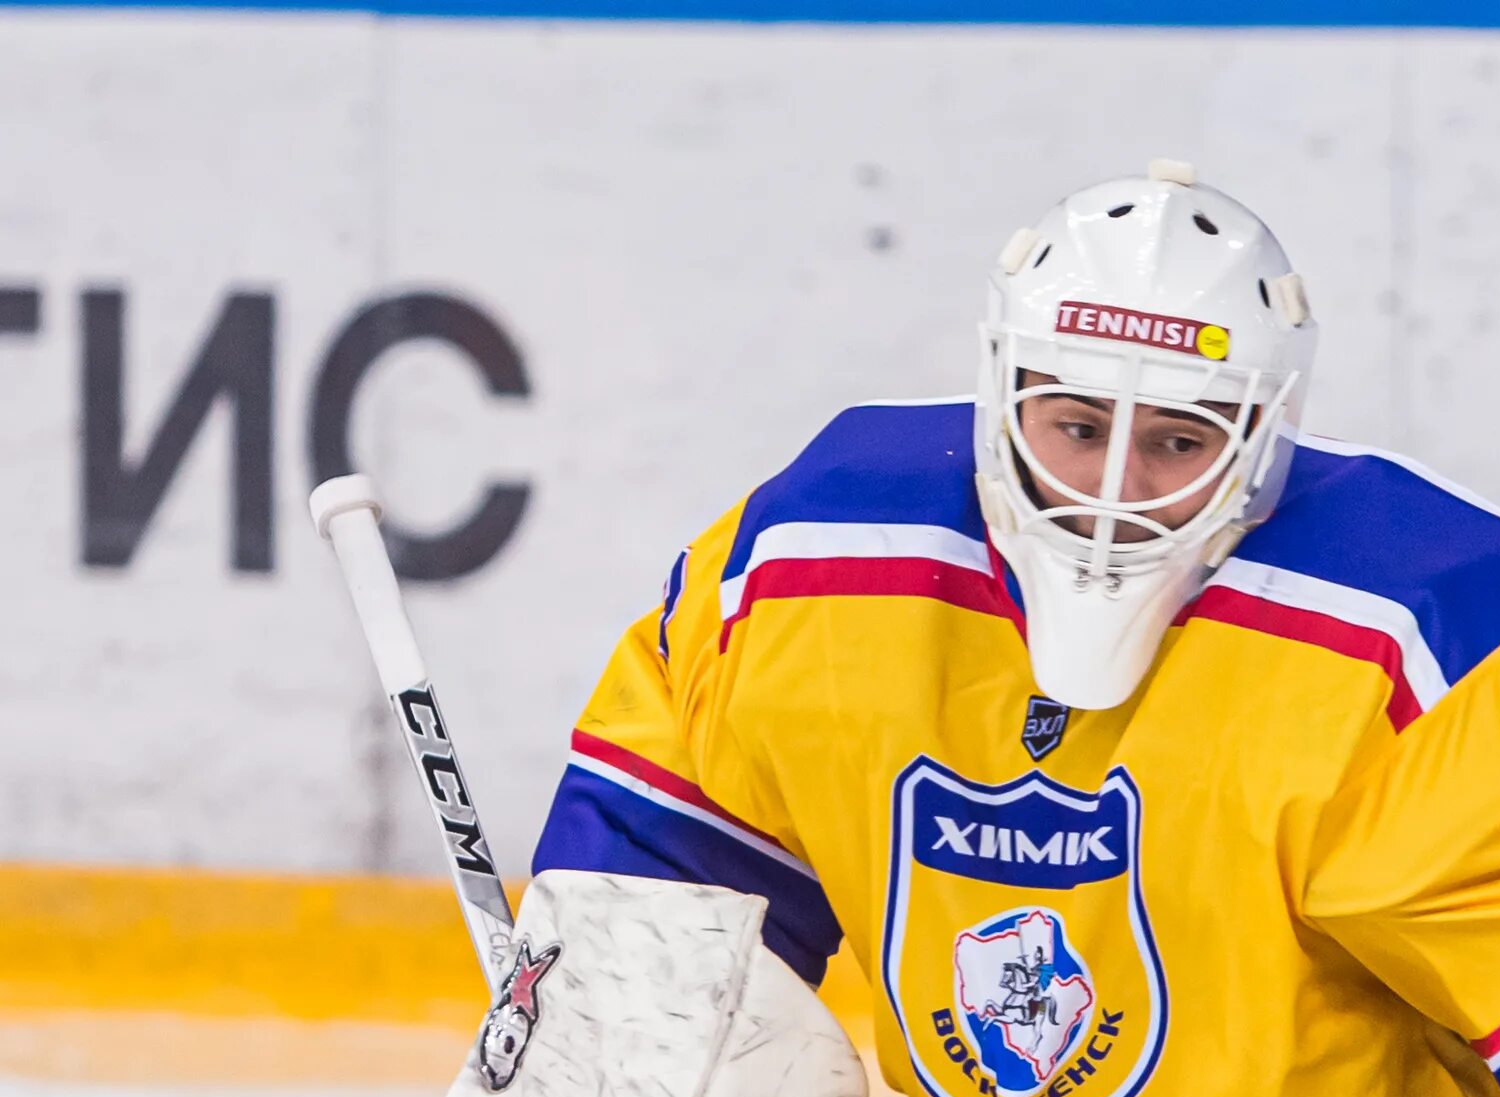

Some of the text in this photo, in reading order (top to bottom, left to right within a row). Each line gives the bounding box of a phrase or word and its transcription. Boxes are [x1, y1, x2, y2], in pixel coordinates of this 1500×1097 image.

[1058, 304, 1196, 347] TENNISI
[397, 684, 497, 877] CCM
[930, 815, 1119, 867] ХИМИК
